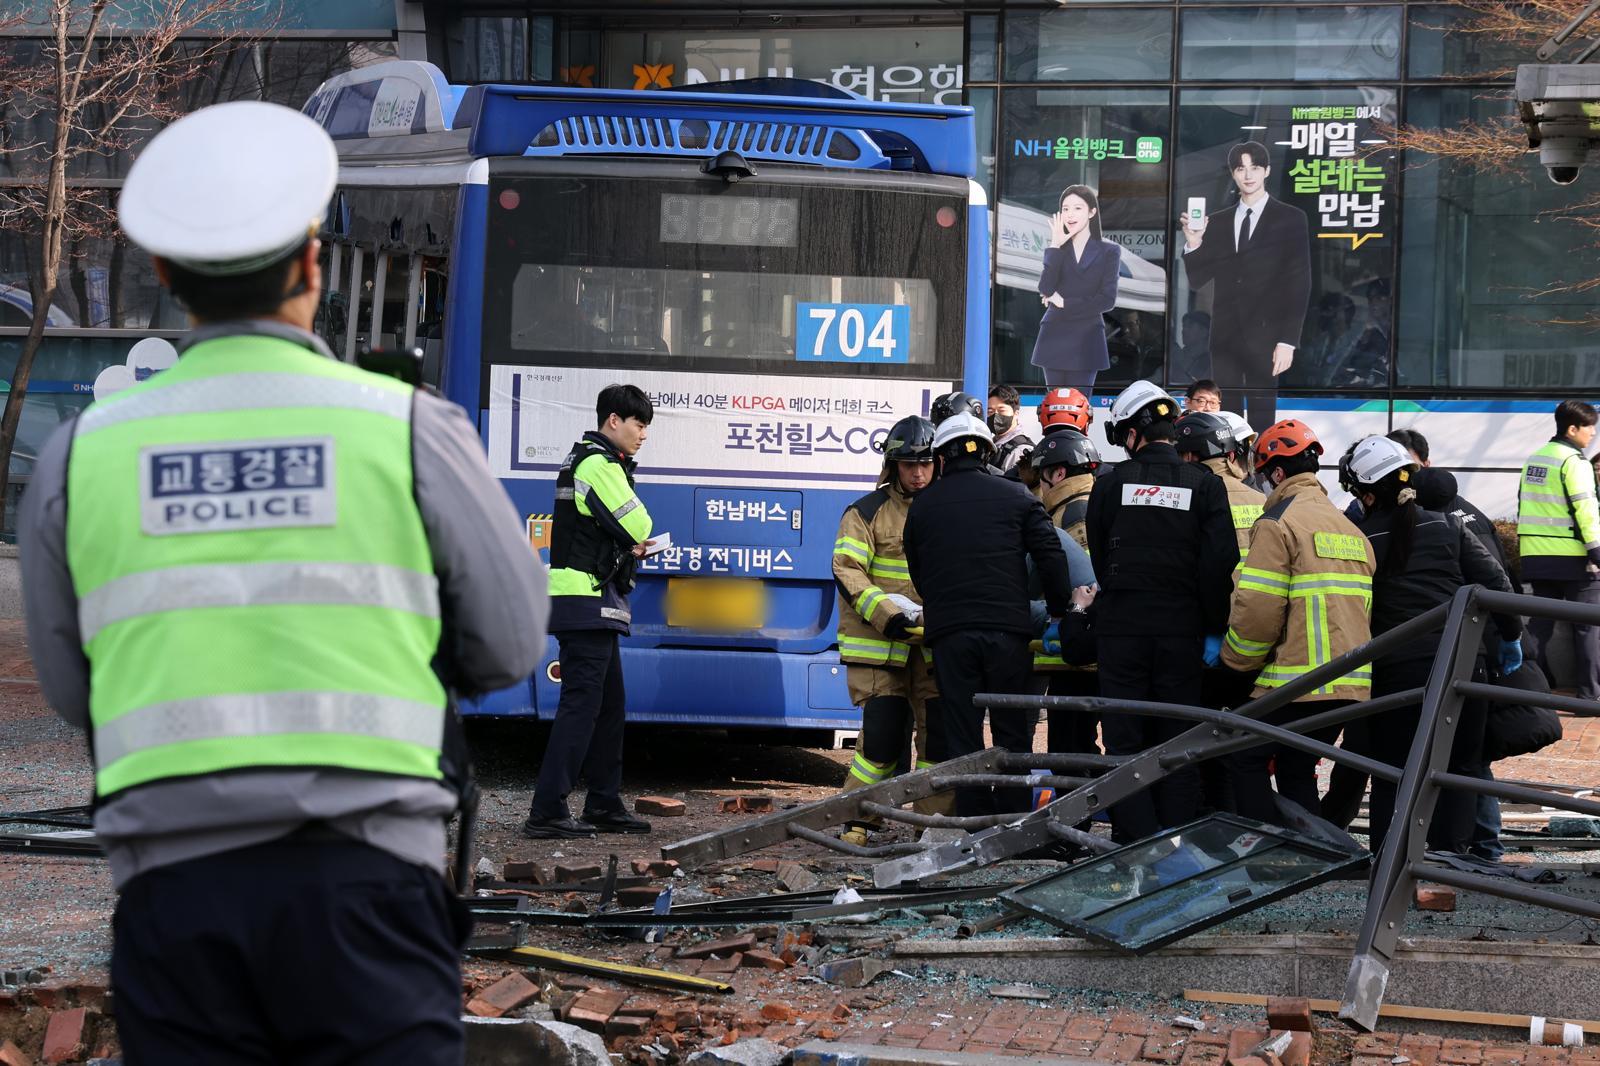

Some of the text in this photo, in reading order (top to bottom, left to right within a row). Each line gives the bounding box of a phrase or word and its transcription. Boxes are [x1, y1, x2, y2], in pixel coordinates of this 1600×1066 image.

[1014, 136, 1125, 160] NH올원뱅크
[1291, 122, 1357, 157] 매일
[1138, 150, 1159, 158] one
[1288, 159, 1386, 194] 설레는
[1318, 193, 1386, 228] 만남
[809, 308, 897, 358] 704
[645, 391, 893, 415] 남에서 40분 KLPGA 메이저 대회 코스
[157, 446, 319, 492] 교통경찰
[1130, 496, 1180, 509] 서울소방
[1133, 486, 1181, 500] 119 구급대
[164, 495, 313, 523] POLICE
[705, 499, 788, 523] 한남버스
[708, 547, 794, 574] 전기버스
